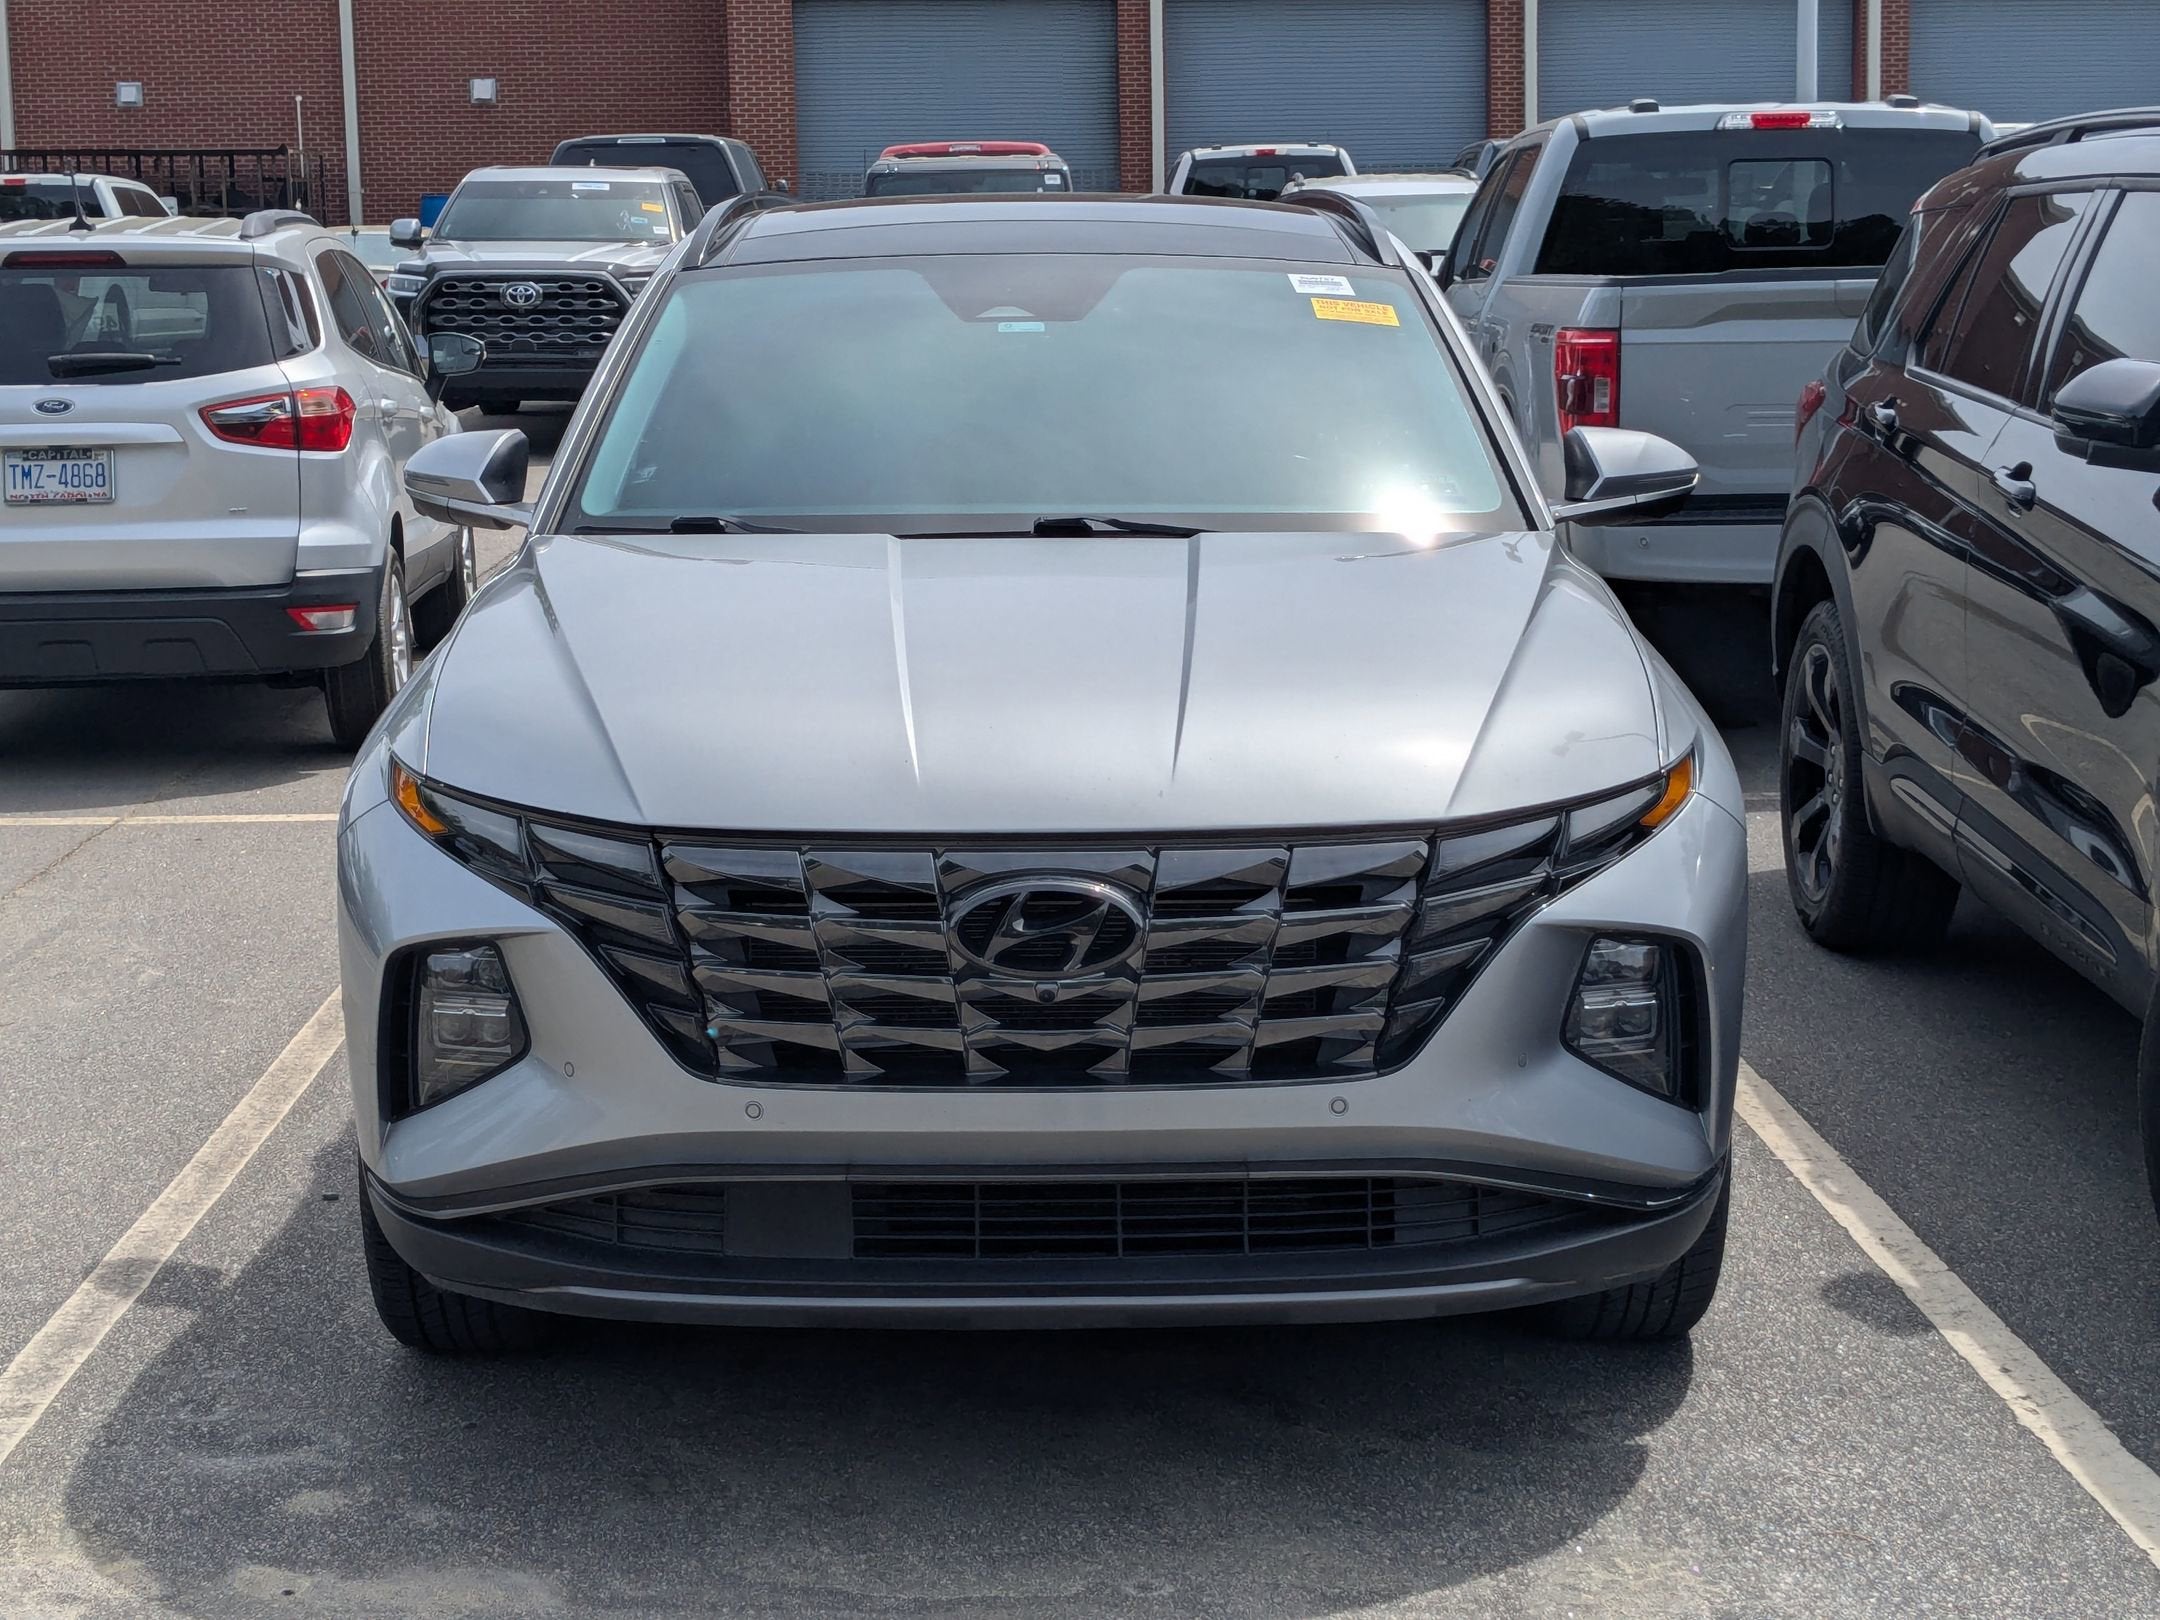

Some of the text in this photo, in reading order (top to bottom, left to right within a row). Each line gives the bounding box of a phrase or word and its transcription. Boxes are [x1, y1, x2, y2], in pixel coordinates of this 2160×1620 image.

[1343, 301, 1390, 311] VEHICLE
[28, 449, 87, 460] CAPITAL
[9, 462, 106, 490] TMZ-4868
